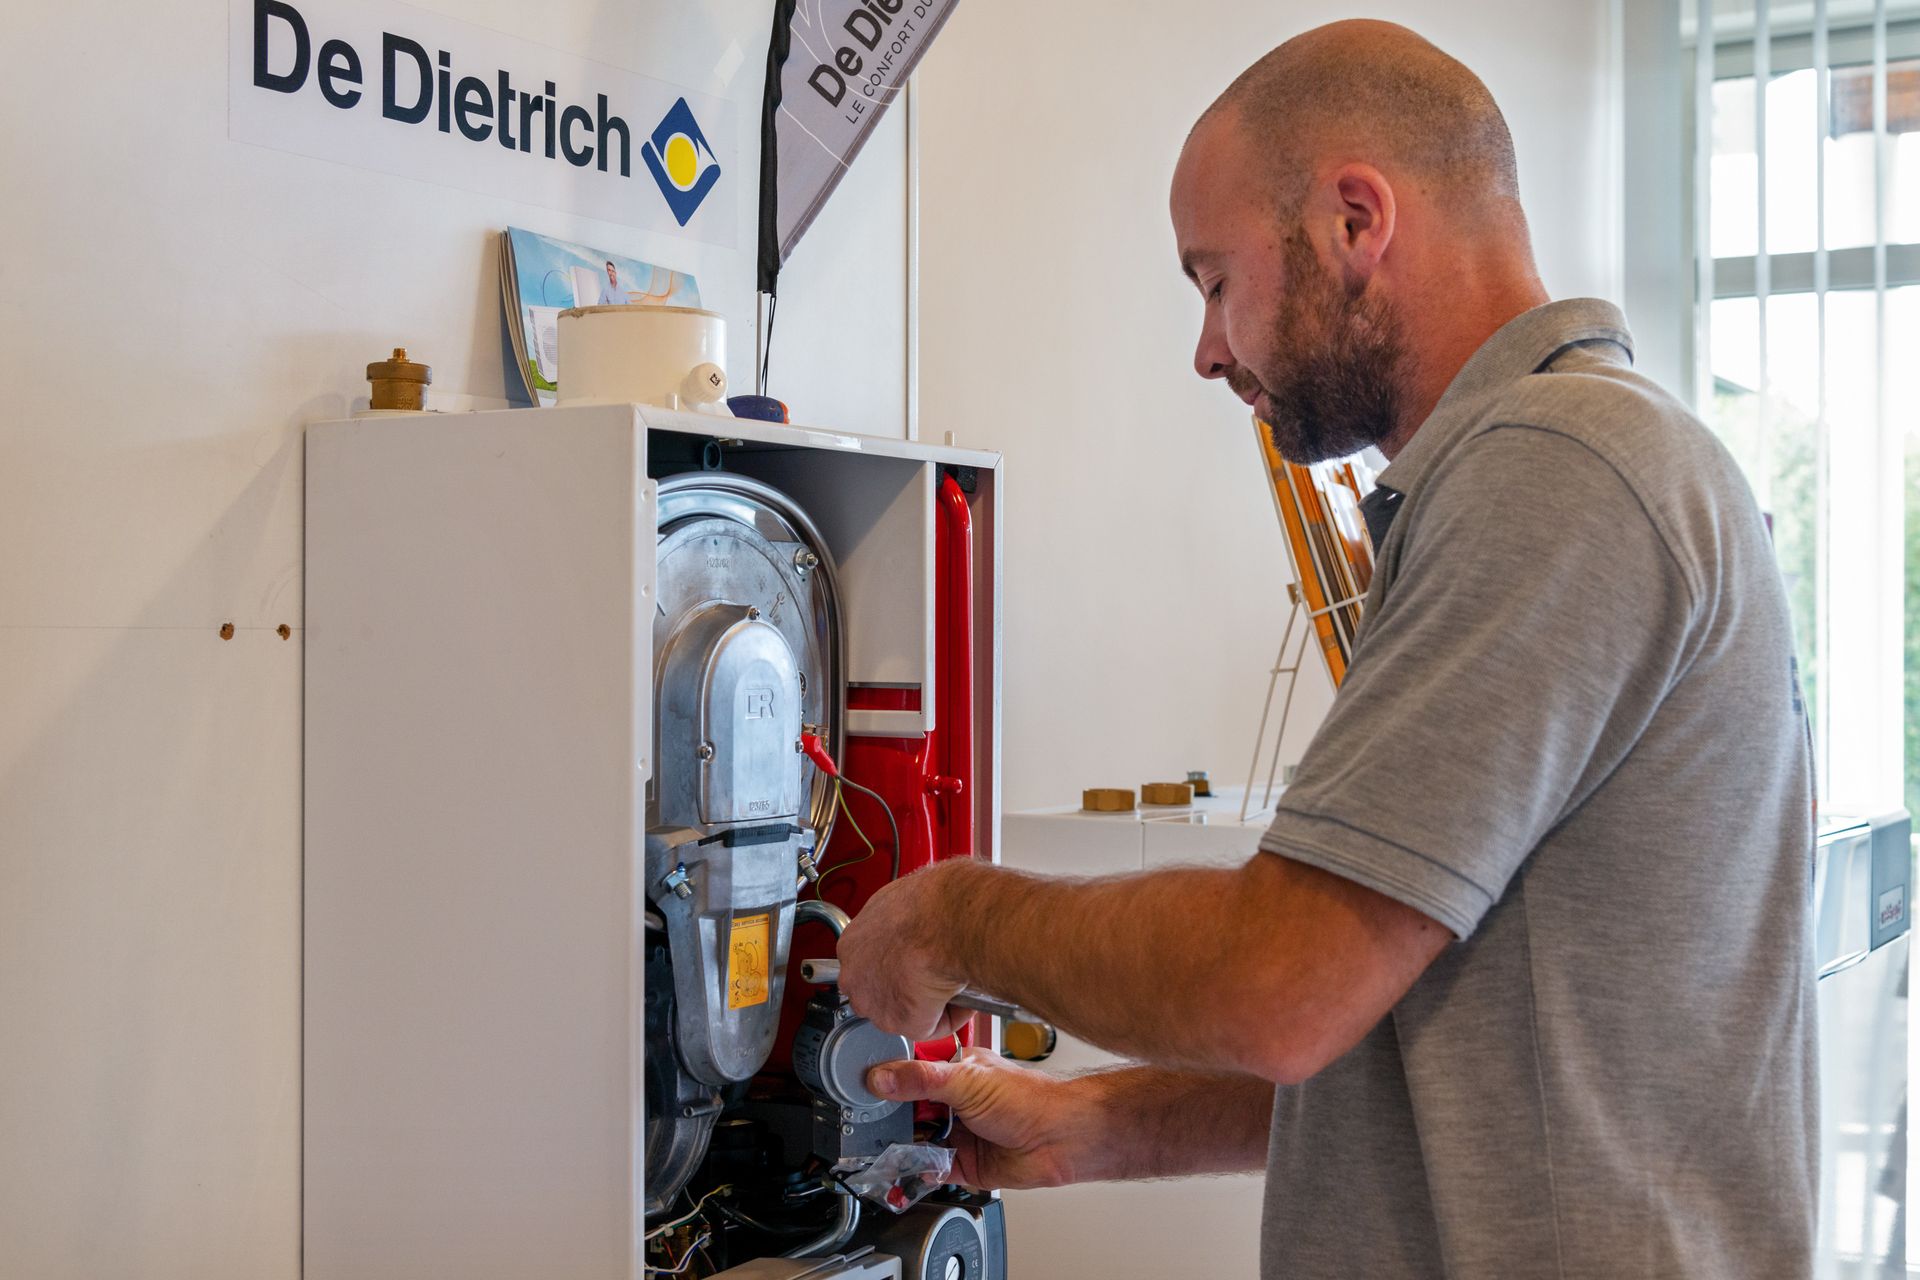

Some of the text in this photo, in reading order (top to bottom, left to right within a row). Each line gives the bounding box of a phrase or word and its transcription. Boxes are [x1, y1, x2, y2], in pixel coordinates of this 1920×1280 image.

[253, 0, 631, 178] De Dietrich
[807, 46, 864, 109] De
[845, 99, 866, 125] LE
[862, 19, 916, 98] CONFORT
